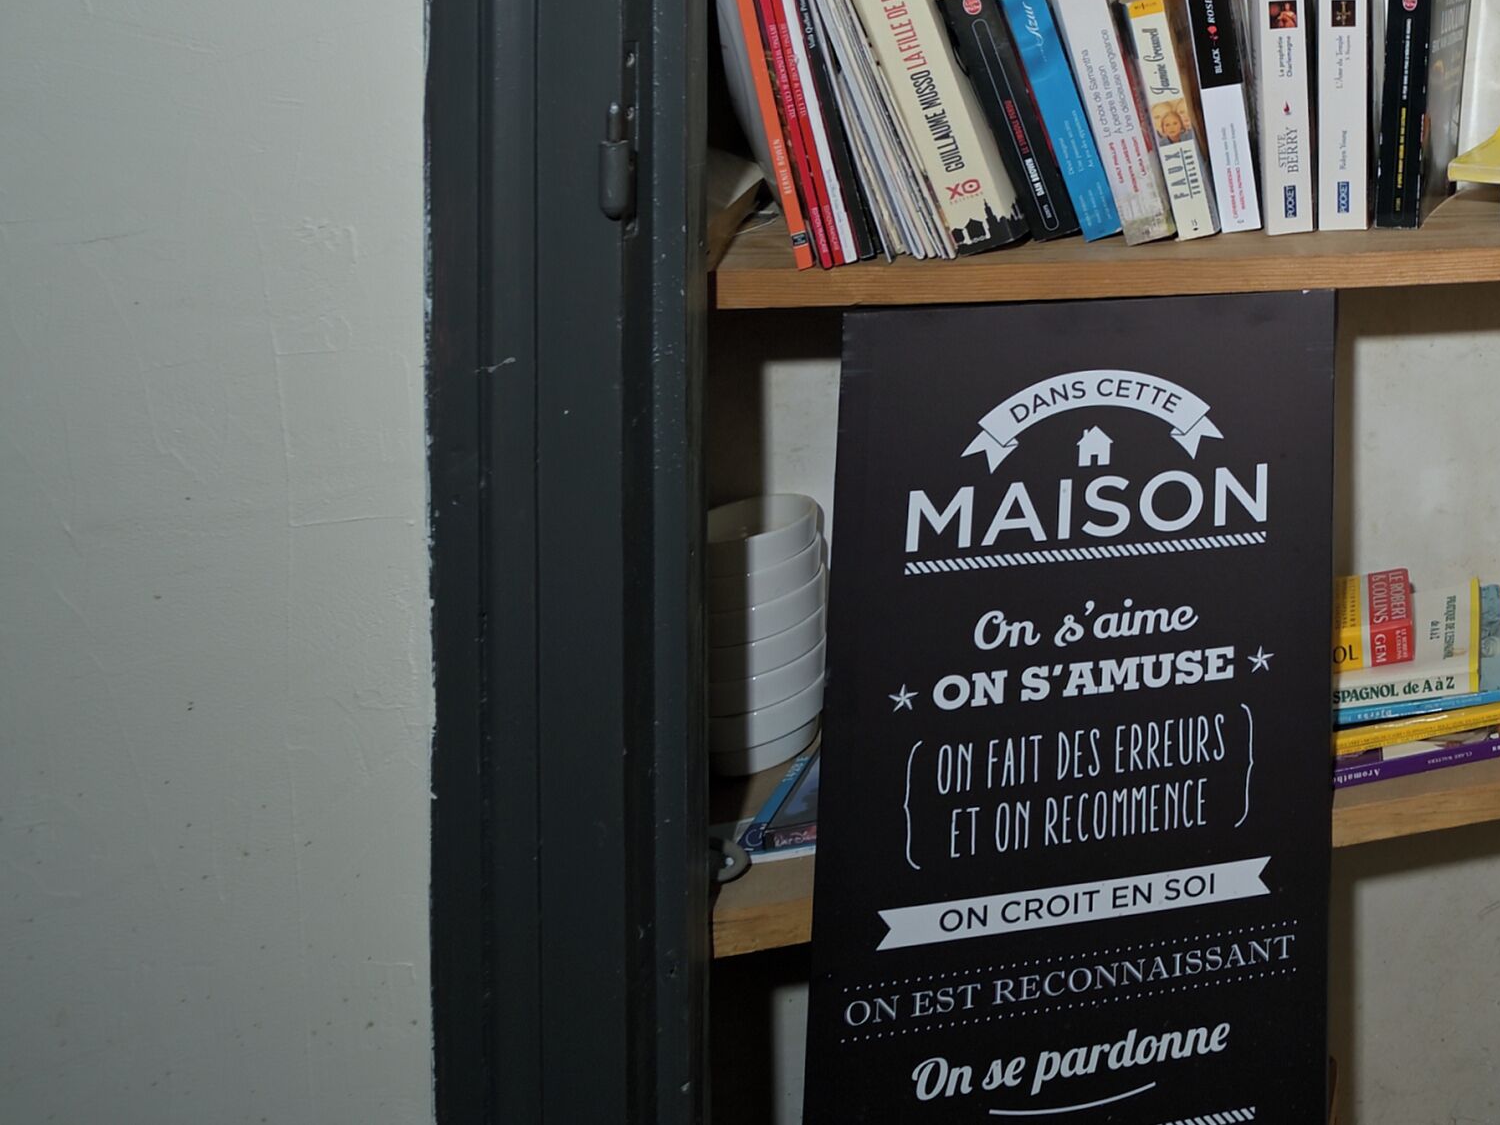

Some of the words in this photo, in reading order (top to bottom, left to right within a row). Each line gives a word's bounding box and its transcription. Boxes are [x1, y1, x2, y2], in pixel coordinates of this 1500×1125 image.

[884, 1, 909, 18] DE
[1022, 1, 1044, 47] Azur
[891, 21, 919, 50] FILLE
[1101, 29, 1121, 72] vengeance
[1277, 36, 1286, 67] prophétie
[906, 51, 929, 70] LA
[1081, 49, 1098, 90] Samantha
[1211, 48, 1223, 74] BLACK
[1285, 36, 1294, 77] Charlemagne
[910, 68, 942, 108] MUSSO
[1098, 66, 1113, 90] raison
[1112, 73, 1131, 113] délicieuse
[1093, 92, 1103, 102] de
[1107, 100, 1123, 125] perdre
[1097, 104, 1110, 126] choix
[1101, 127, 1112, 138] Le
[1121, 114, 1135, 132] Une
[924, 109, 966, 173] GUILLAUME
[1277, 134, 1287, 168] STEVE
[1286, 127, 1299, 173] BERRY
[1025, 158, 1041, 181] BROWN
[1164, 151, 1188, 200] FAUX
[945, 179, 980, 200] XO
[1030, 182, 1045, 196] DAN
[1284, 185, 1296, 218] POCKET
[1337, 181, 1349, 214] POCKET
[1009, 379, 1087, 424] DANS
[1096, 378, 1183, 414] CETTE
[905, 463, 1268, 552] MAISON
[1389, 572, 1402, 582] LE
[1372, 581, 1388, 623] COLLINS
[1390, 583, 1405, 619] ROBERT
[973, 610, 1040, 650] On
[1054, 598, 1198, 647] s'aime
[1375, 634, 1387, 663] GEM
[932, 670, 1007, 710] ON
[1020, 646, 1235, 701] S'AMUSE
[1333, 682, 1399, 704] SPAGNOL
[1403, 681, 1419, 695] de
[1422, 679, 1433, 693] A
[1435, 677, 1443, 691] à
[1446, 676, 1455, 689] Z
[936, 743, 973, 795] ON
[986, 735, 1043, 789] FAIT
[1057, 728, 1100, 781] DES
[1114, 713, 1226, 775] ERREURS
[950, 806, 978, 858] ET
[994, 799, 1030, 853] ON
[1044, 778, 1208, 847] RECOMMENCE
[938, 905, 988, 933] ON
[1000, 889, 1100, 924] CROIT
[1112, 883, 1153, 909] EN
[1164, 872, 1216, 901] SOI
[844, 995, 899, 1027] ON
[910, 984, 981, 1018] EST
[992, 935, 1295, 1005] RECONNAISSANT
[911, 1057, 973, 1102] On
[981, 1057, 1027, 1087] se
[1030, 1021, 1231, 1096] pardonne
